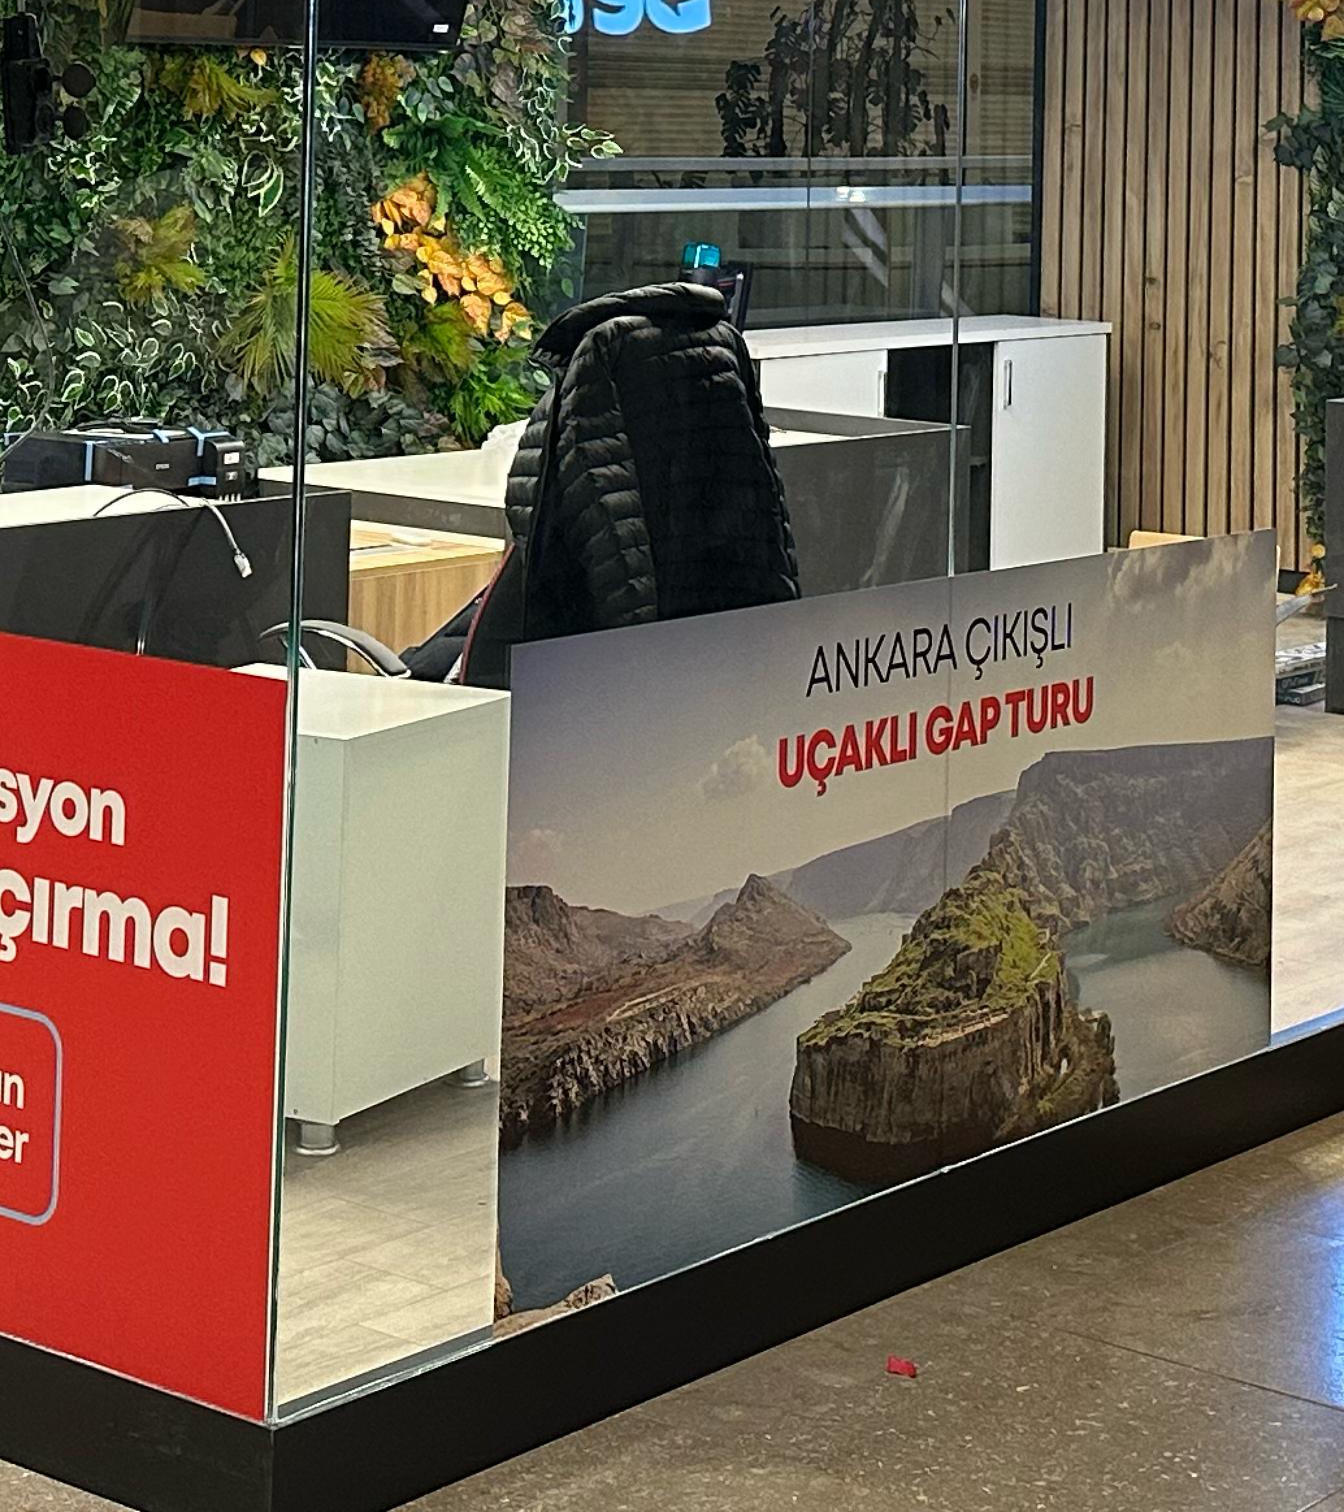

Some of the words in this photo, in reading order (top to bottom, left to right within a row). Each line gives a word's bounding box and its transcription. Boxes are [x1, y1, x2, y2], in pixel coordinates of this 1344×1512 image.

[806, 623, 957, 697] ANKARA
[965, 602, 1073, 680] ÇIKIŞLI
[778, 711, 917, 797] UÇAKLI
[925, 696, 1001, 756] GAP
[1005, 676, 1094, 737] TURU
